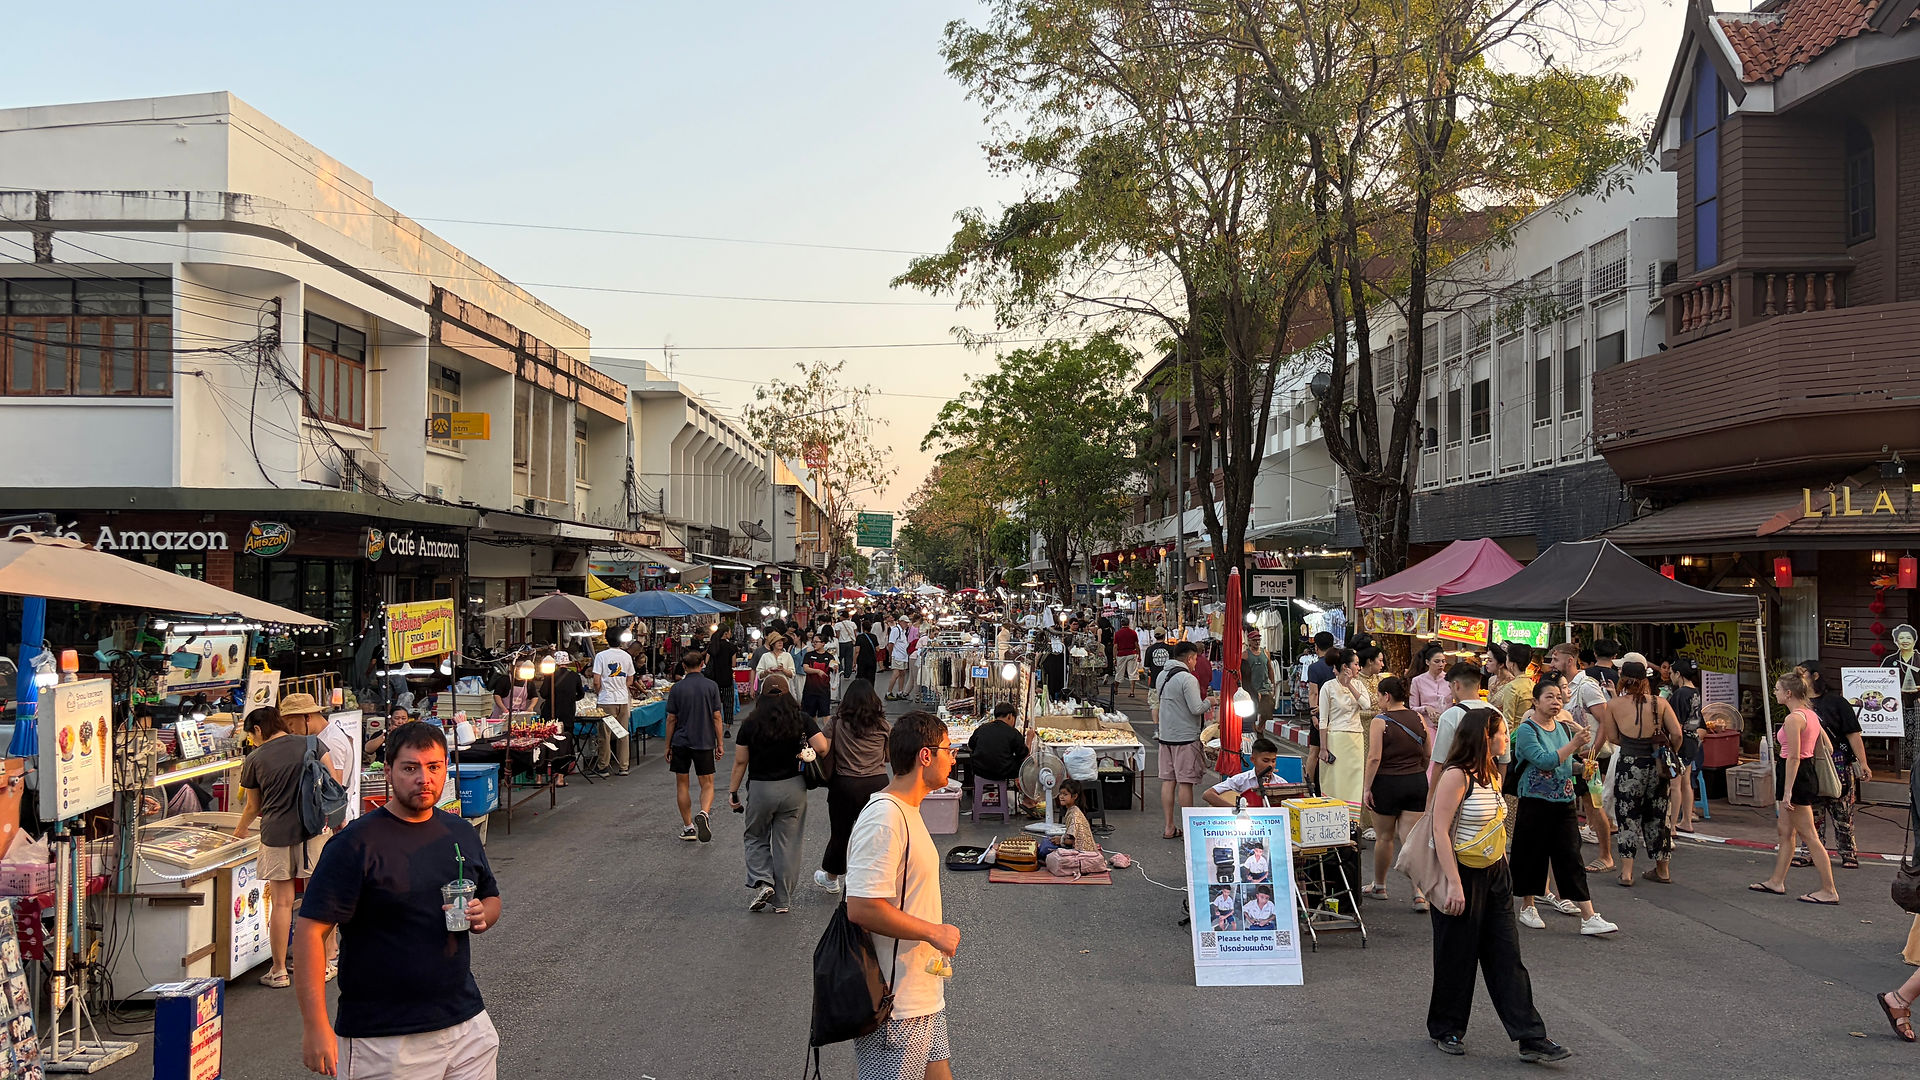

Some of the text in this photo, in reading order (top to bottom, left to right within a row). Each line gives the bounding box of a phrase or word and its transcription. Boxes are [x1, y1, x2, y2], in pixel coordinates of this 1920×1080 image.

[95, 526, 229, 550] Amazon
[389, 528, 460, 558] Café Amazon
[411, 633, 424, 642] STICKS
[432, 630, 441, 638] BAHT
[1864, 714, 1884, 722] 350
[1243, 935, 1258, 943] help
[1220, 944, 1273, 952] โปรดช่วยผมด้วย
